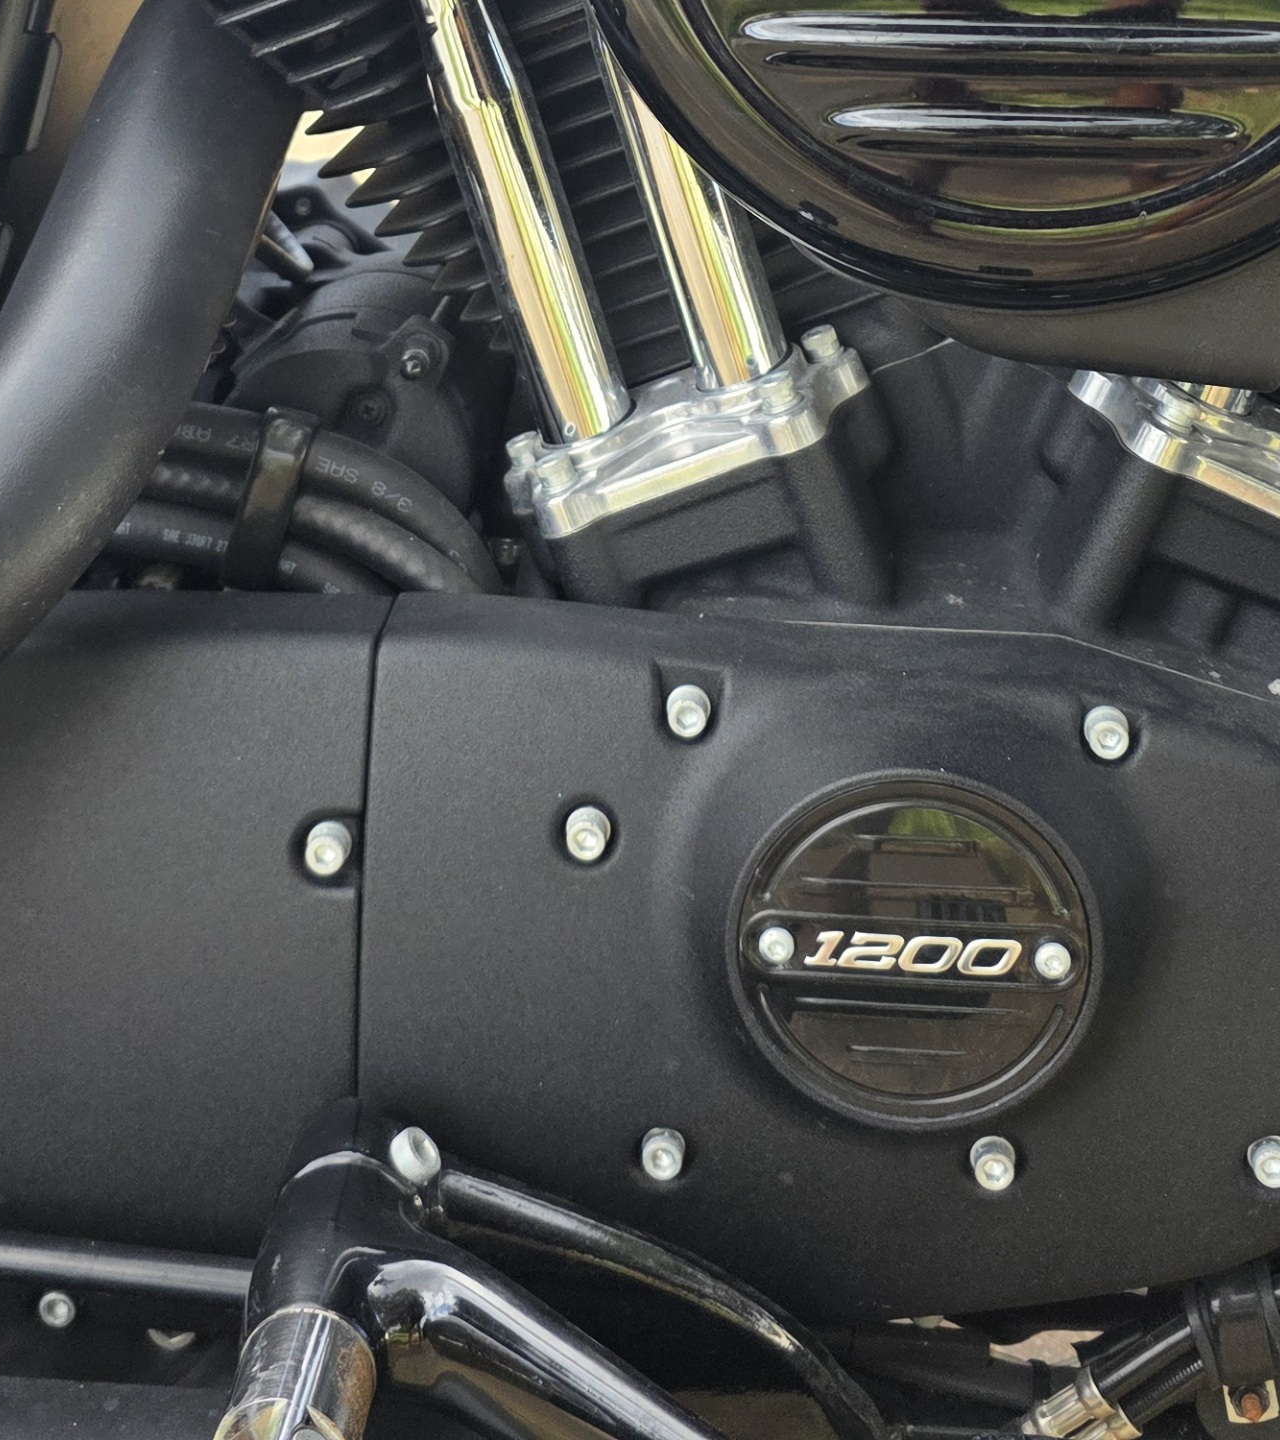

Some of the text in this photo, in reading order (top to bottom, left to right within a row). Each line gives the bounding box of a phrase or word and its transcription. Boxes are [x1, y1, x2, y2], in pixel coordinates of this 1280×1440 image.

[317, 455, 360, 485] SAE
[371, 480, 413, 513] 3/8
[804, 930, 1022, 976] 1200
